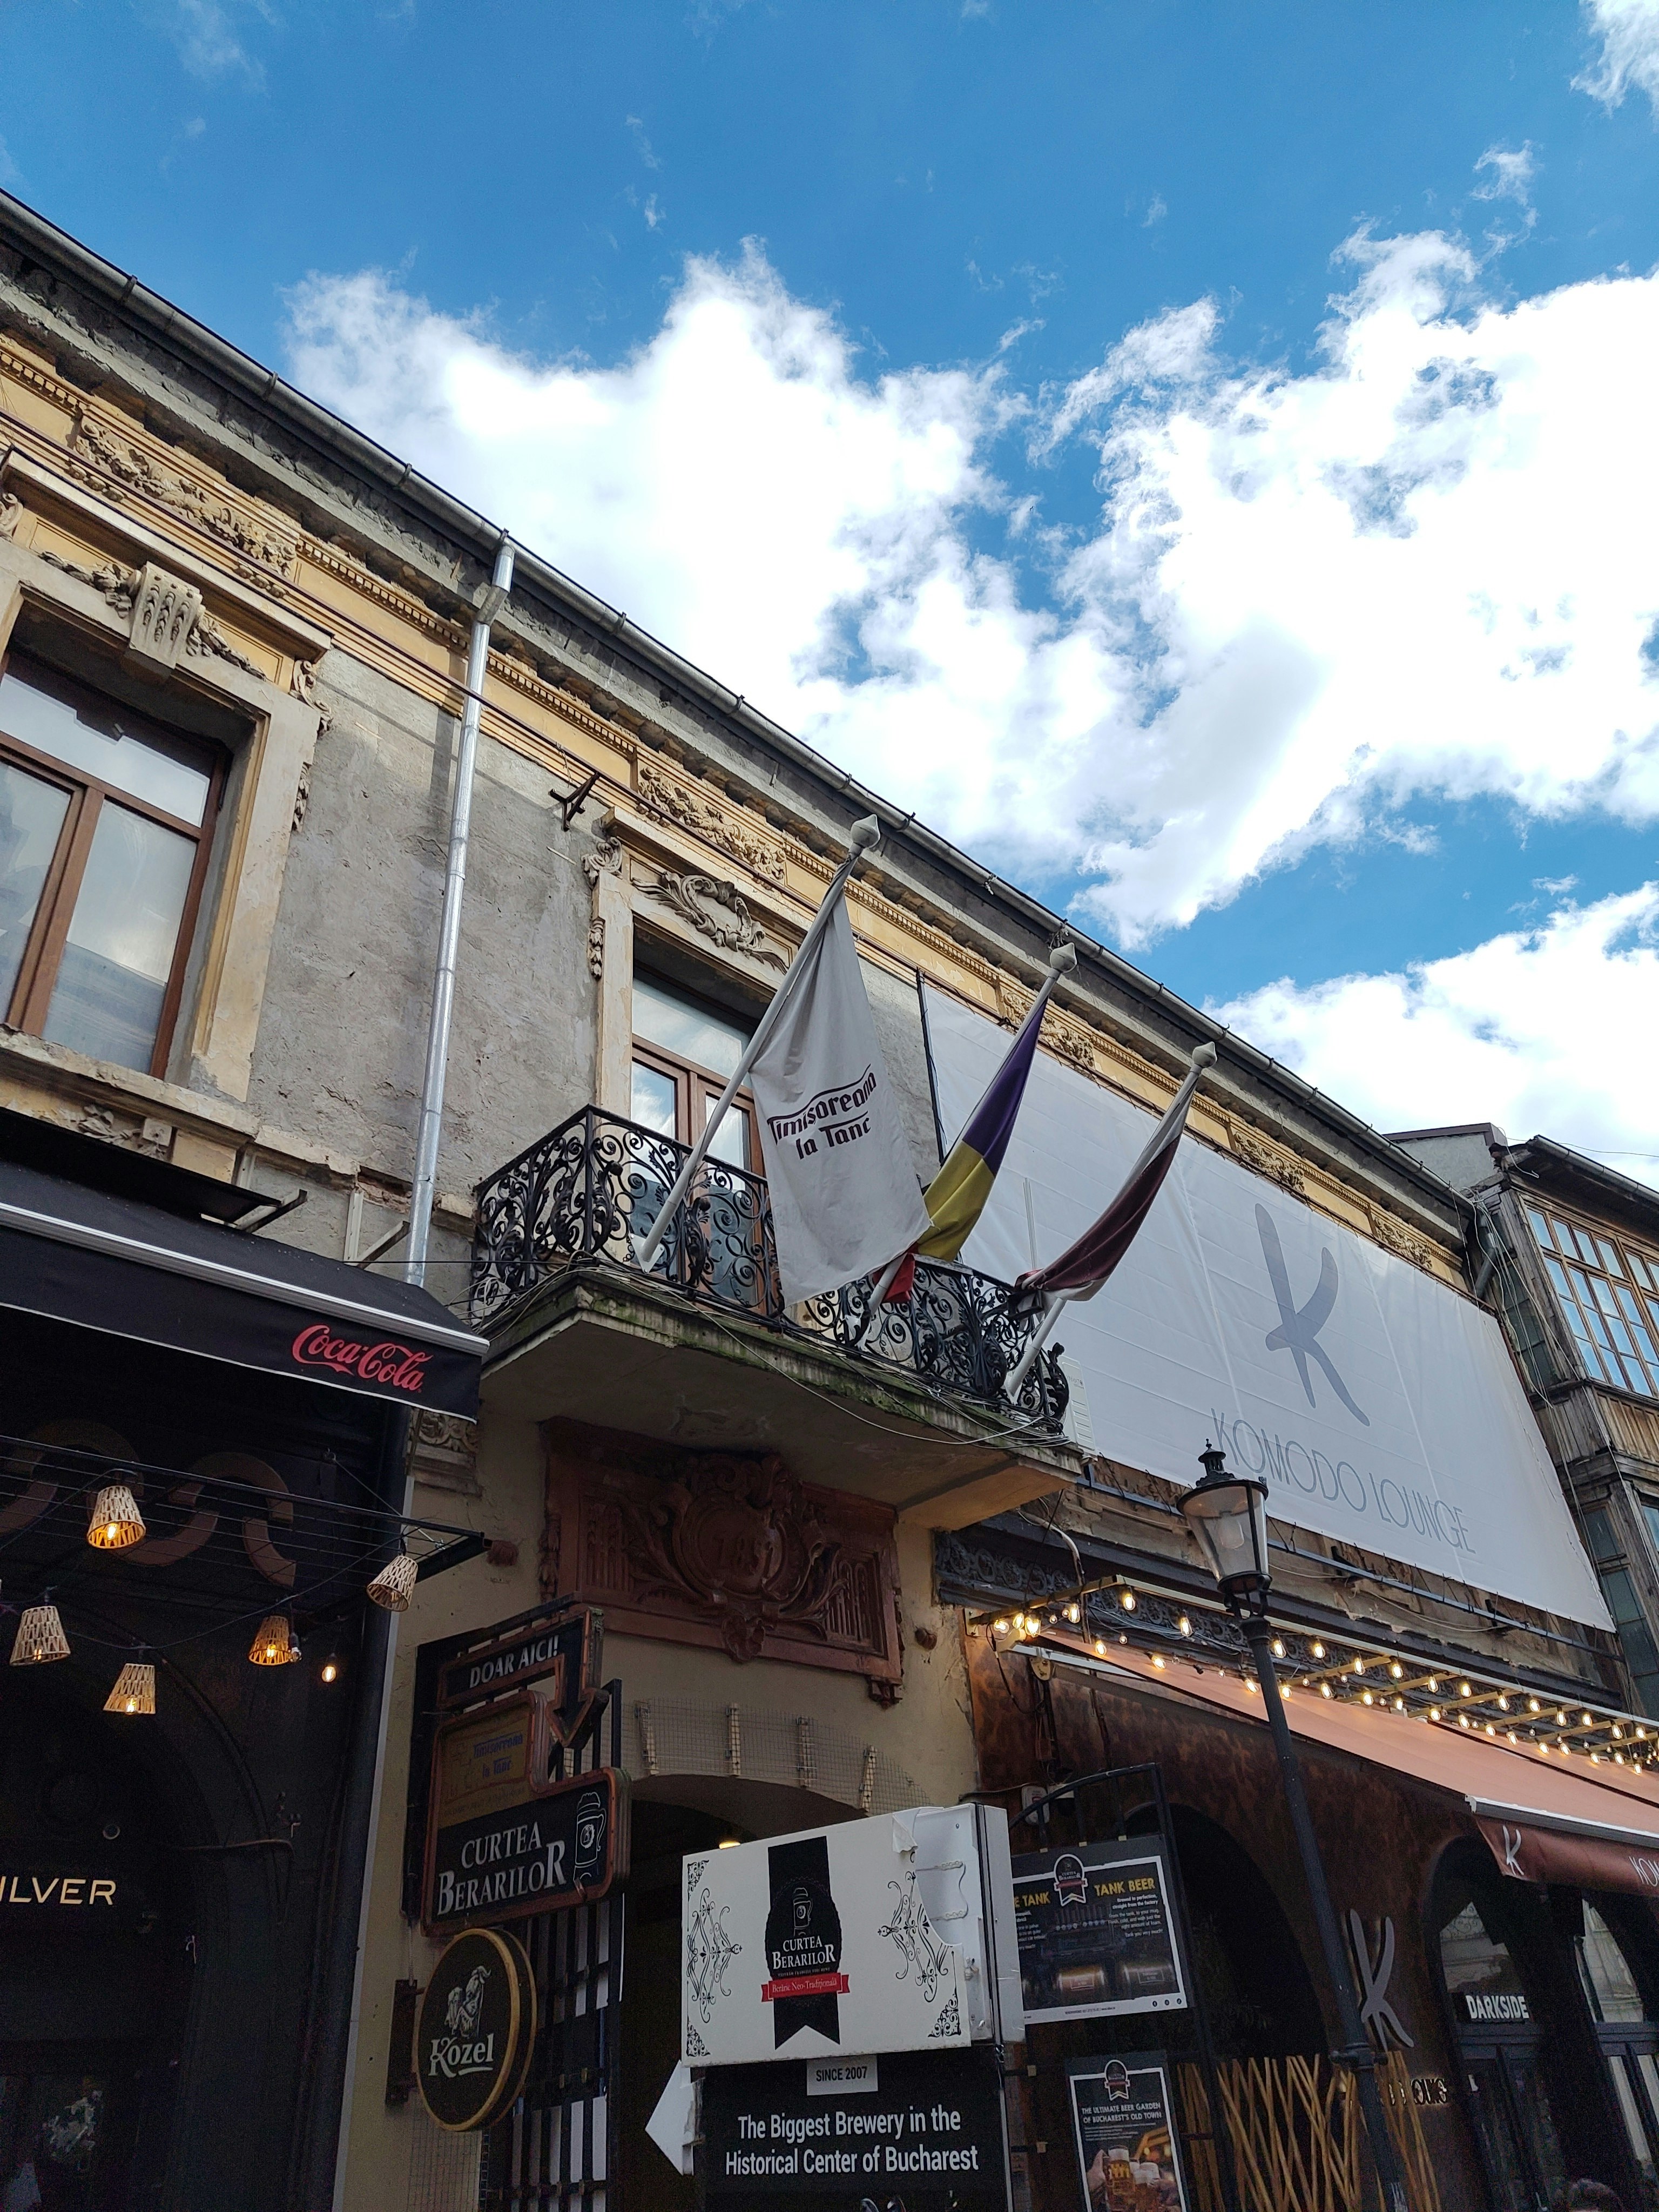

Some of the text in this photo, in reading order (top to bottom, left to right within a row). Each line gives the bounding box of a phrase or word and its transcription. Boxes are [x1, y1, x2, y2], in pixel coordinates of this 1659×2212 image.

[796, 1111, 872, 1159] la Tanc
[292, 1325, 434, 1392] Coca-Cola
[1211, 1408, 1476, 1554] KOMODO LOUNGE
[469, 1635, 559, 1689] DOAR AICI!
[461, 1822, 542, 1869] CURTEA
[437, 1840, 567, 1916] BERARILOR
[1094, 1878, 1156, 1897] TANK BEER
[1022, 1892, 1051, 1907] TANK
[772, 1944, 836, 1970] BERARILOR
[783, 1936, 822, 1952] CURTEA
[1466, 1994, 1530, 2020] DARKSIDE
[428, 2033, 494, 2078] Kozel
[816, 2066, 868, 2082] SINCE 2007
[738, 2104, 961, 2144] The Biggest Brewery in the
[1093, 2105, 1120, 2114] ULTIMATE
[1136, 2102, 1161, 2110] GARDEN
[726, 2143, 979, 2175] Historical Center of Bucharest
